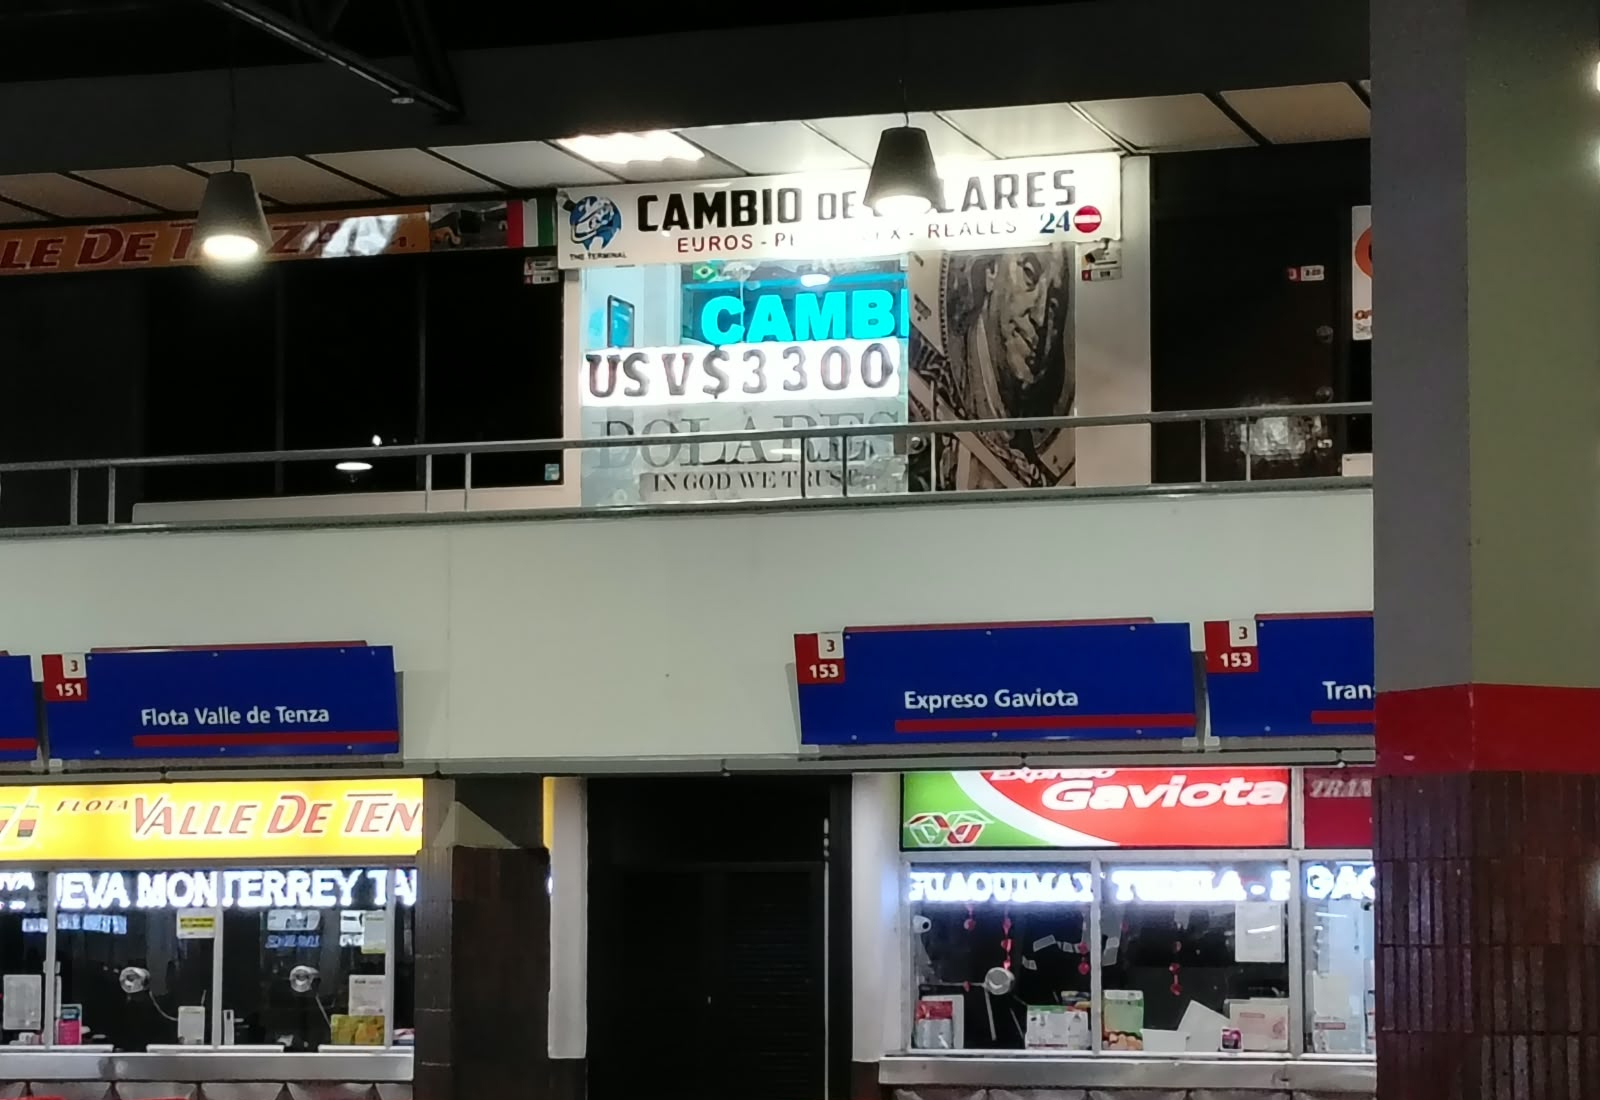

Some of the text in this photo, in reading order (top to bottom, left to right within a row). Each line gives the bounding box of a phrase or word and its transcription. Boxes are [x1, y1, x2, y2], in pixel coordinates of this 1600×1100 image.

[637, 169, 1076, 232] CAMBIO DE ARES
[1040, 210, 1071, 234] 24
[77, 226, 158, 266] DE
[678, 233, 754, 253] EUROS
[653, 472, 677, 492] IN
[683, 471, 731, 491] GOD
[740, 470, 777, 489] WE
[1237, 626, 1249, 641] 3
[825, 639, 837, 653] 3
[70, 659, 79, 673] 3
[809, 663, 839, 679] 153
[1220, 652, 1253, 669] 153
[56, 682, 83, 698] 151
[904, 687, 1080, 714] Expreso Gaviota
[141, 705, 329, 726] Flota Valle de Tenza
[1041, 774, 1288, 811] Gaviota
[57, 792, 423, 836] FLOTA VALLE DE TEN
